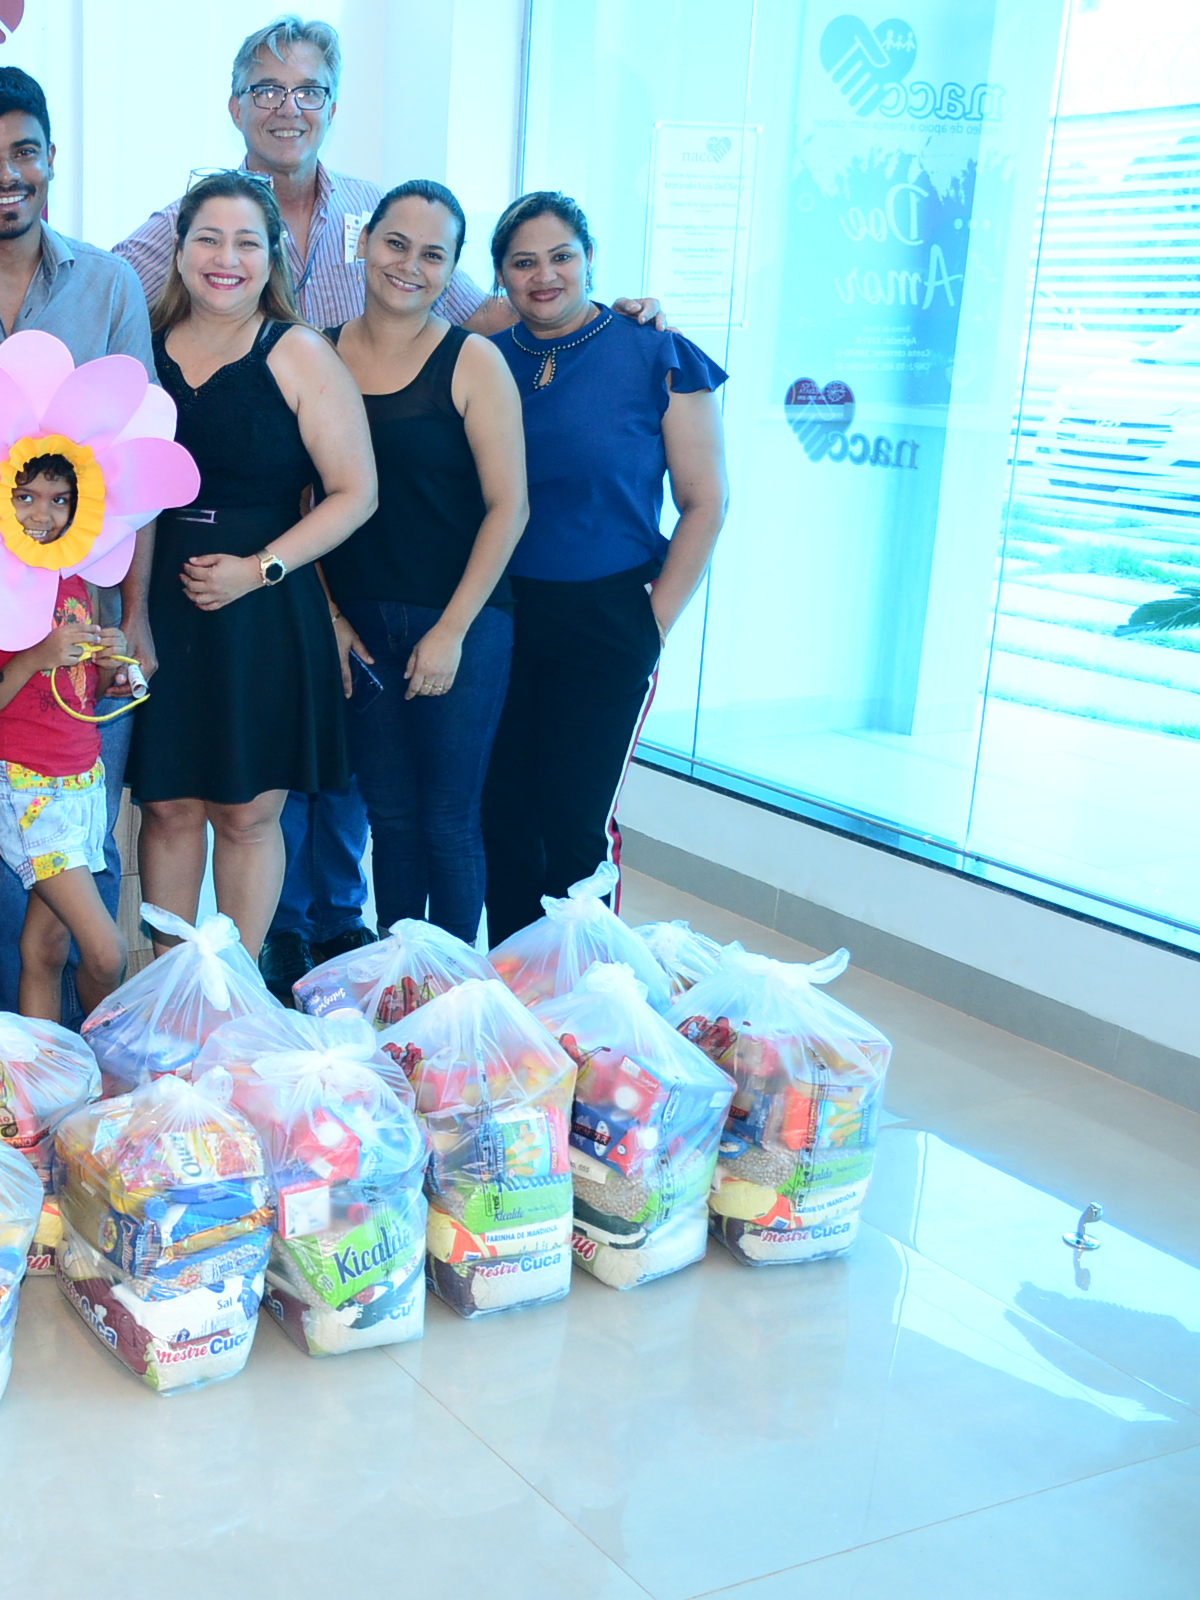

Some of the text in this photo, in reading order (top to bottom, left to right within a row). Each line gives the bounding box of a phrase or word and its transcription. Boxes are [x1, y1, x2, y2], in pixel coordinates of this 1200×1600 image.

[486, 1224, 558, 1243] FARINHA DE MANDIOCA
[811, 1222, 851, 1240] Cuca
[520, 1252, 562, 1273] Cuca
[217, 1297, 233, 1310] Sal
